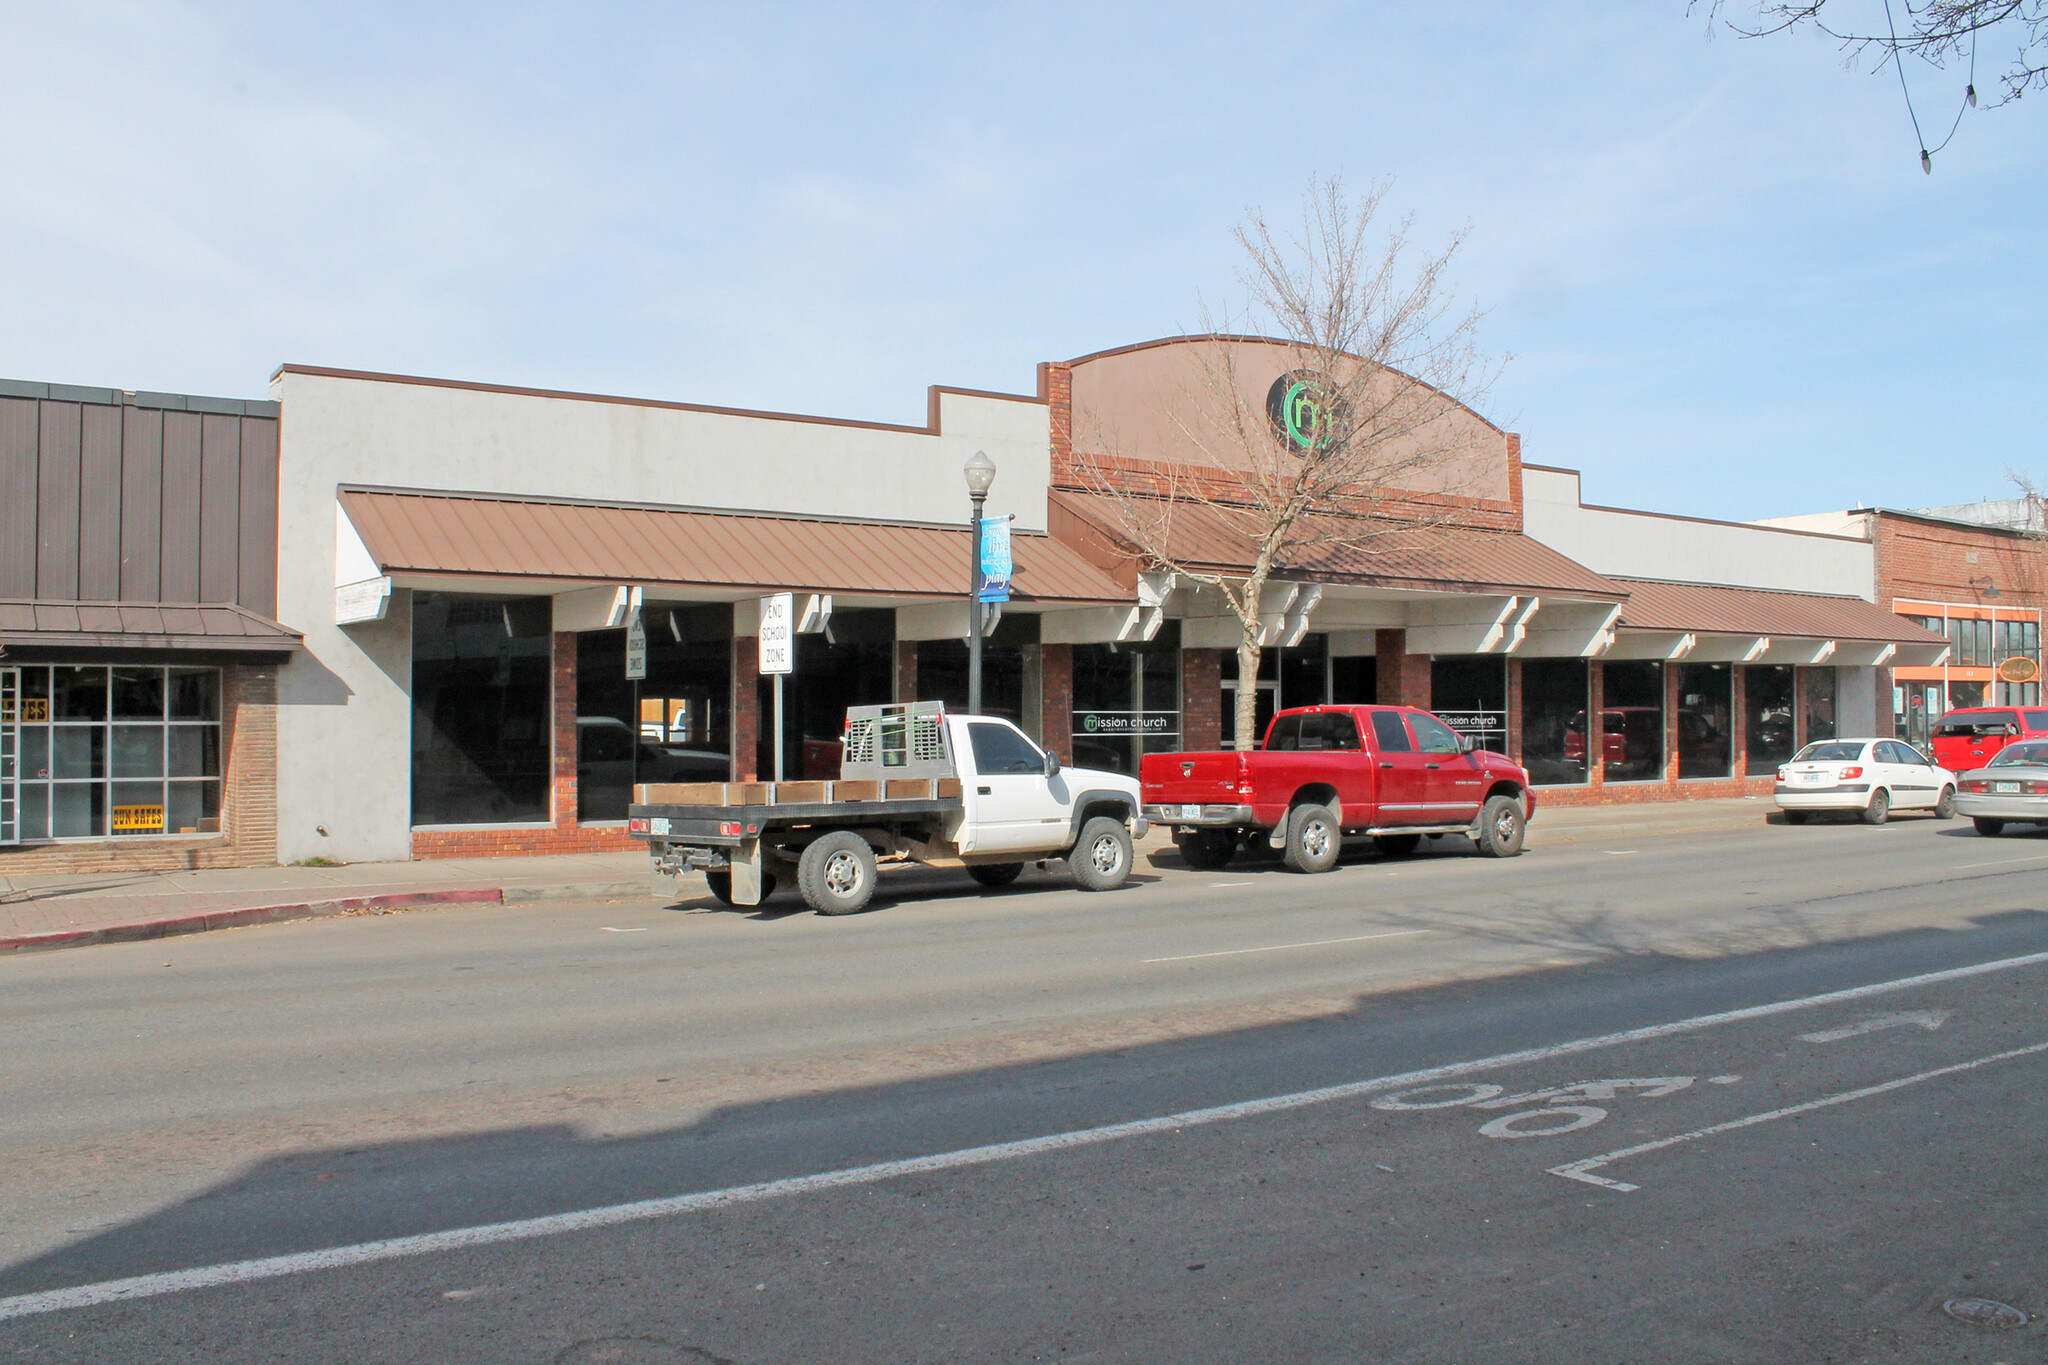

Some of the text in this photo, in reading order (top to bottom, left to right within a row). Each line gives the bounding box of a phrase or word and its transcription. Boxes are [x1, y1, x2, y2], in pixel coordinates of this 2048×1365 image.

[981, 567, 1006, 591] play
[768, 604, 783, 619] END
[766, 648, 785, 663] ZONE
[1131, 716, 1167, 727] church
[1470, 716, 1497, 725] church
[134, 809, 162, 824] SAFES
